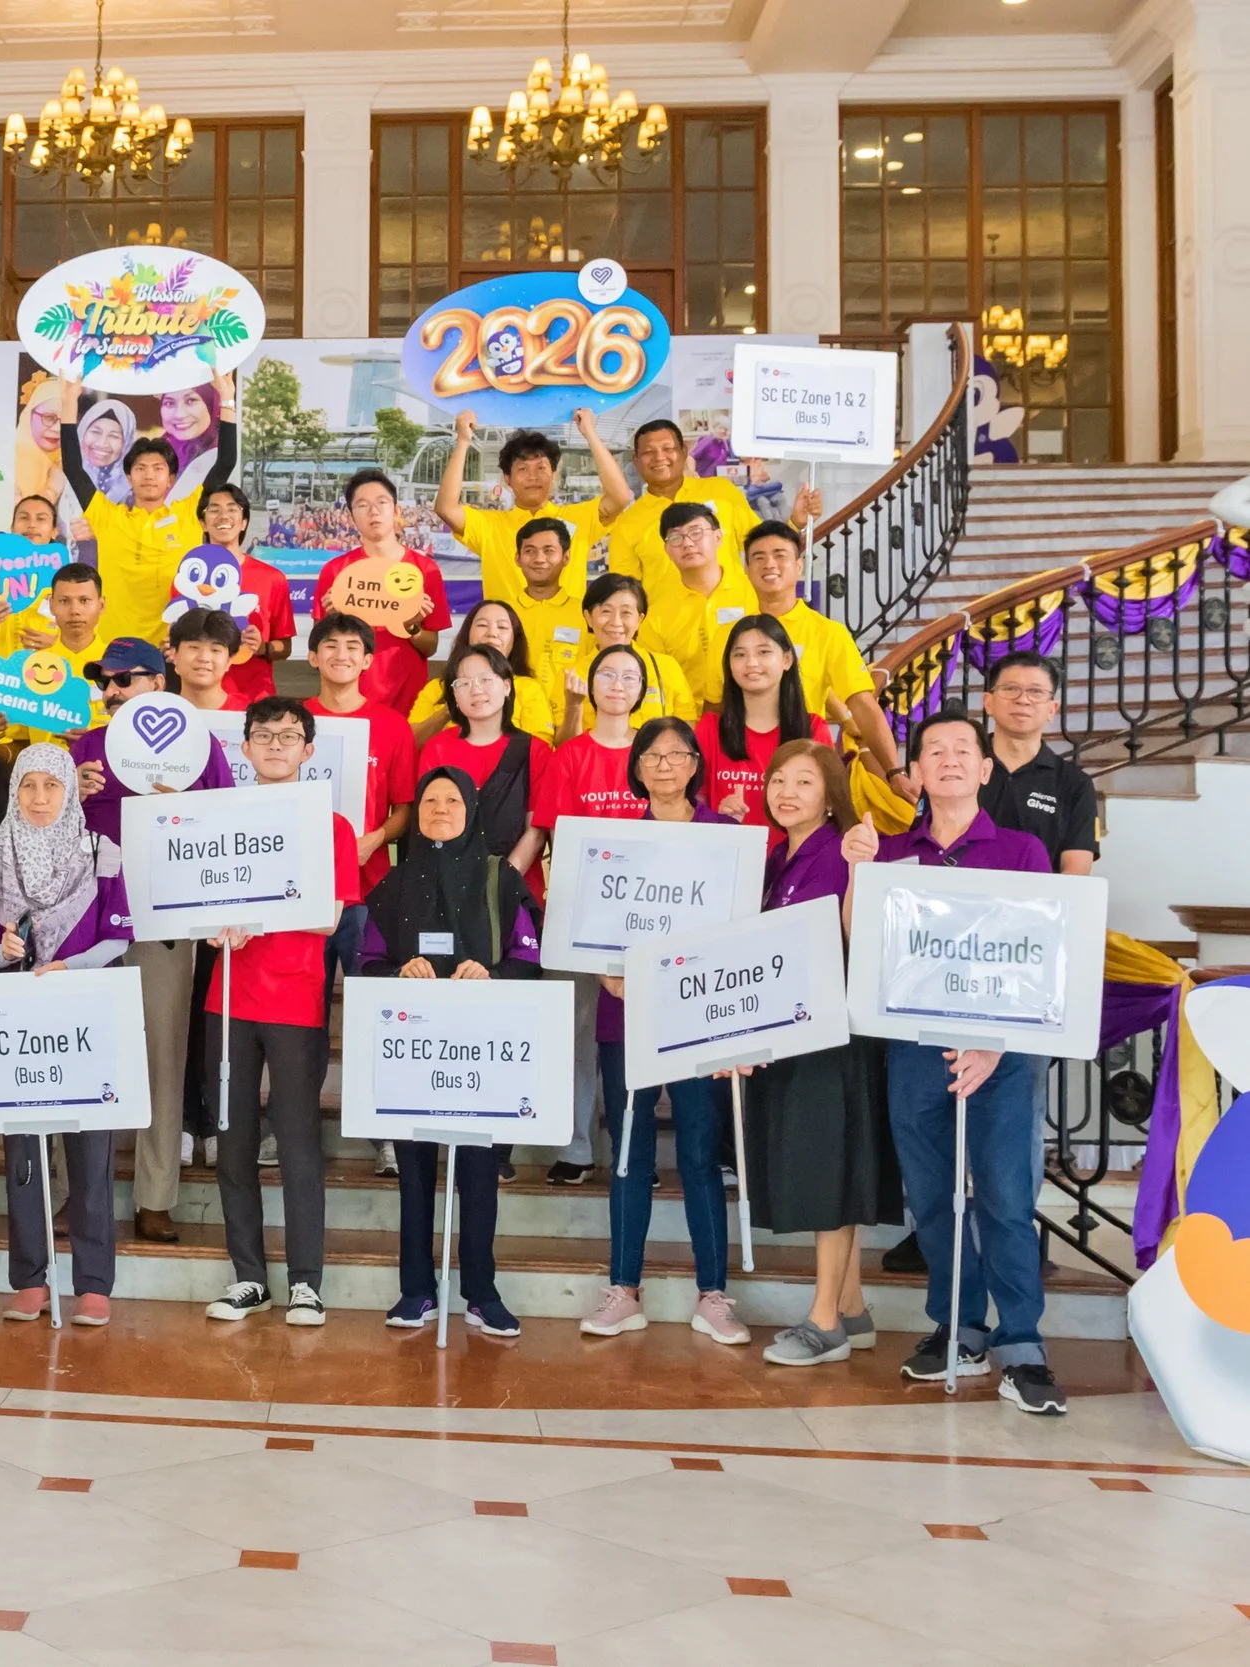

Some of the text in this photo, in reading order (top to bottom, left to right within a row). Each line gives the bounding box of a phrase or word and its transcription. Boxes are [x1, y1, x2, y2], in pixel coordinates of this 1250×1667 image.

[133, 282, 198, 303] Blossom
[80, 298, 201, 336] Tribute
[75, 337, 152, 356] to Seniors
[420, 298, 652, 398] 2026
[761, 387, 866, 408] SC EC Zone 1 & 2
[795, 411, 831, 427] (Bus 5)
[289, 588, 307, 601] ith
[347, 576, 381, 592] I am
[121, 758, 190, 774] Blossom Seeds
[717, 770, 758, 782] YOUTH
[580, 791, 619, 803] YOUTH
[1027, 798, 1056, 814] Gives
[168, 832, 285, 861] Naval Base
[200, 865, 252, 888] (Bus 12)
[601, 874, 706, 906] SC Zone K
[625, 911, 671, 935] (Bus 9)
[909, 929, 1043, 965] Woodlands
[679, 955, 783, 1000] CN Zone 9
[944, 972, 1002, 998] (Bus 11)
[705, 994, 759, 1023] (Bus 10)
[17, 1029, 69, 1055] Zone
[76, 1027, 92, 1052] K
[382, 1038, 531, 1062] SC EC Zone 1 & 2
[14, 1064, 63, 1087] (Bus 8)
[431, 1070, 481, 1092] (Bus 3)
